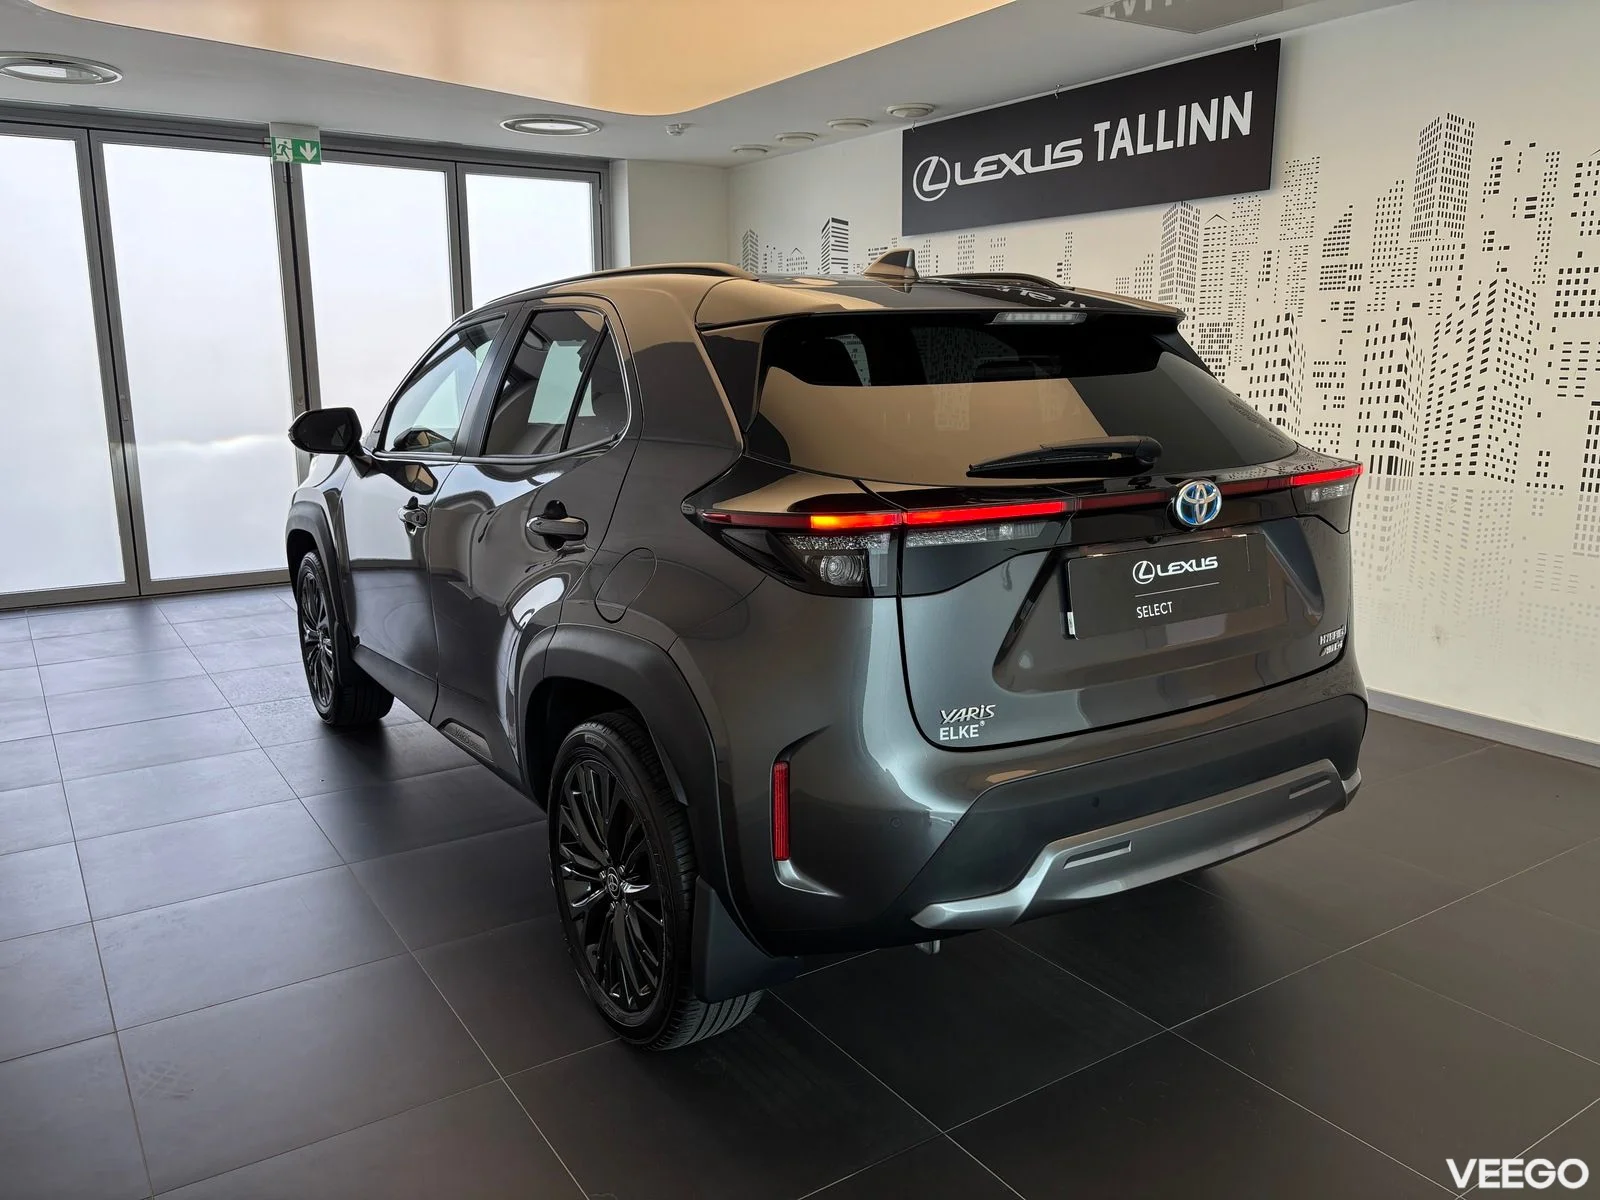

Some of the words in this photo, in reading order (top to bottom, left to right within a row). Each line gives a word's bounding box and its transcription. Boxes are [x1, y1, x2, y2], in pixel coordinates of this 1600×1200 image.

[954, 137, 1084, 187] LEXUS
[1093, 90, 1254, 163] TALLINN
[1156, 556, 1218, 577] LEXUS
[1136, 601, 1173, 619] SELECT
